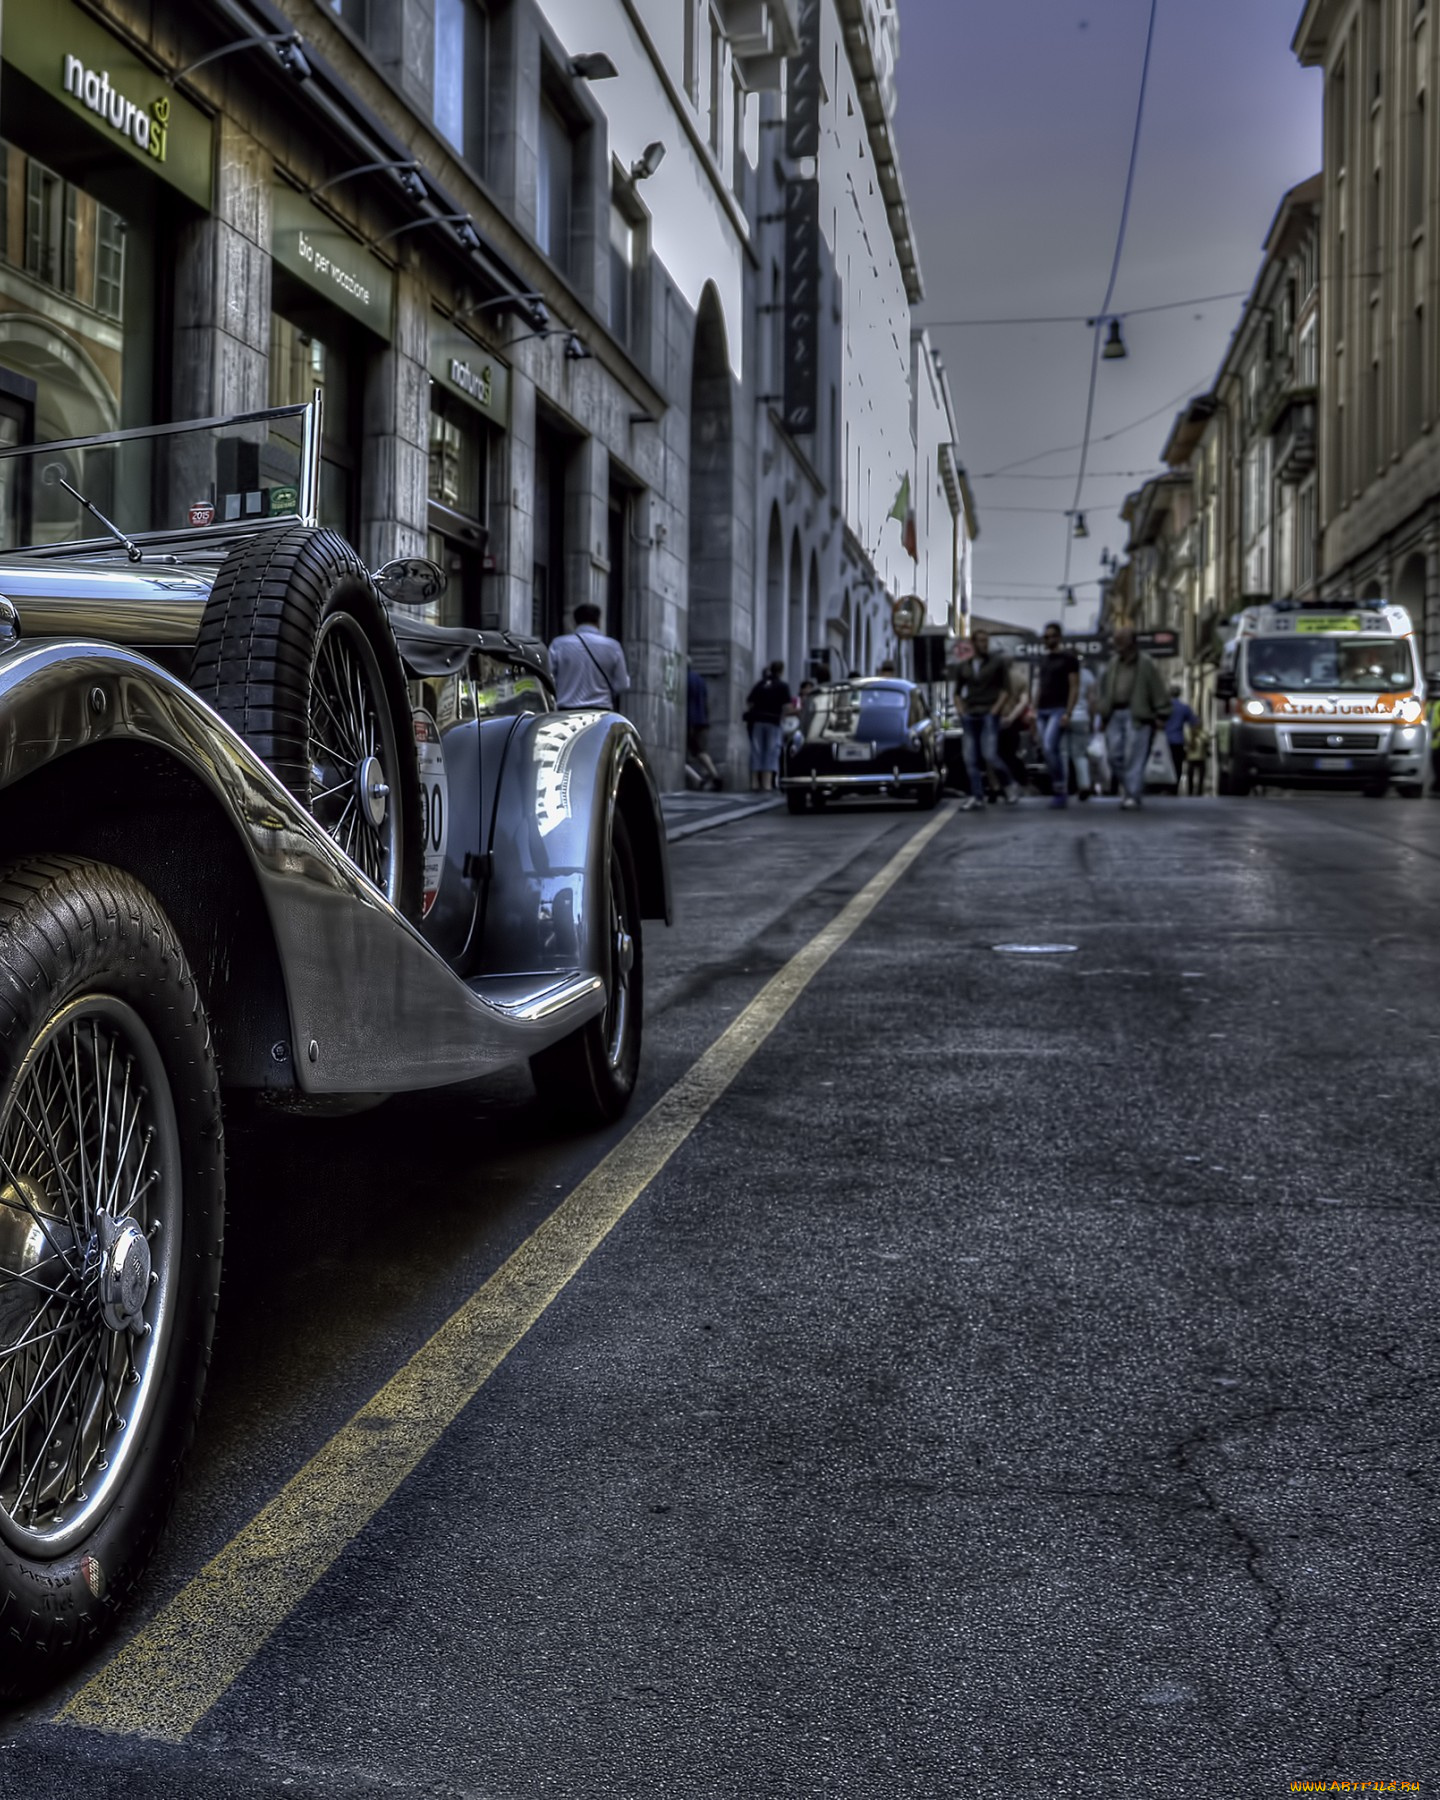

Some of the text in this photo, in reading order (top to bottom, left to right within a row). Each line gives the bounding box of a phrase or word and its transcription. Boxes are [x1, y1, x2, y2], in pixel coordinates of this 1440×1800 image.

[299, 231, 314, 262] bio
[314, 252, 329, 274] per
[191, 510, 210, 520] 2015
